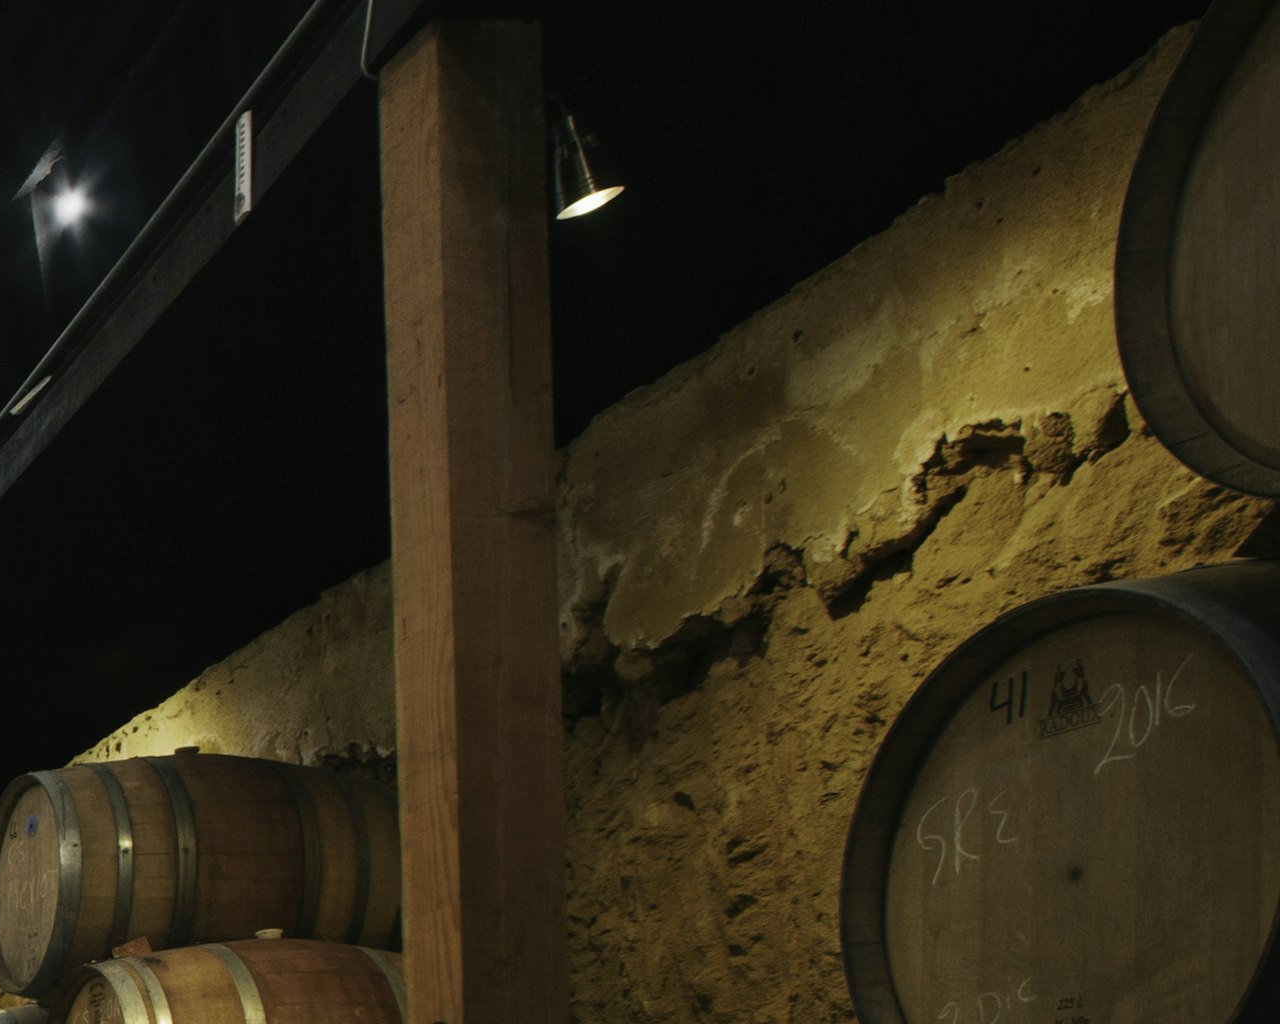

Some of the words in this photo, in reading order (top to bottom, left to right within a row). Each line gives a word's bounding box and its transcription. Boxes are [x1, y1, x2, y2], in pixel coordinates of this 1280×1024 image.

[990, 671, 1028, 724] 41
[1038, 703, 1102, 737] RADOUX
[1094, 653, 1197, 776] 2016
